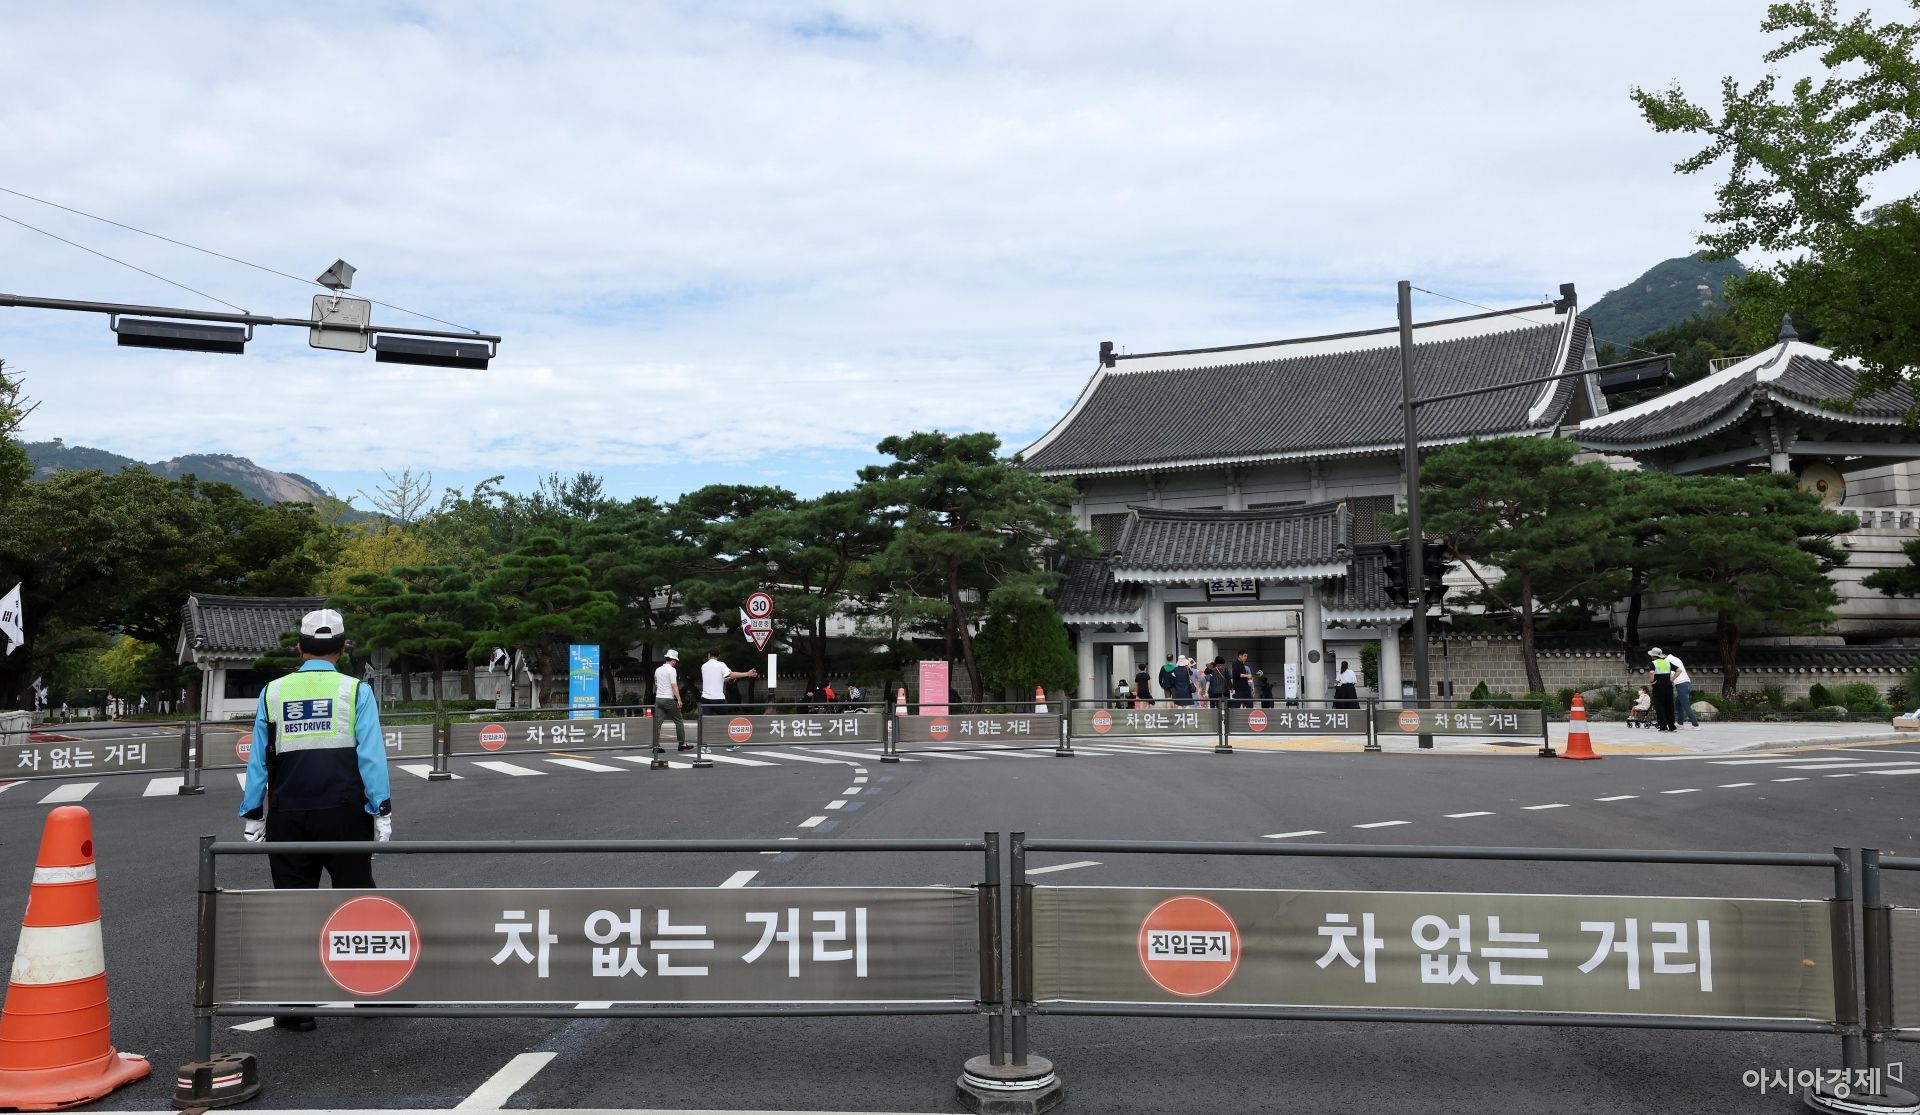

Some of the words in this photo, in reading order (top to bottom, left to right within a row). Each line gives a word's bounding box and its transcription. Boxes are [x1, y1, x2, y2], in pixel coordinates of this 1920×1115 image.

[752, 600, 766, 612] 30
[286, 700, 329, 720] 종로
[285, 722, 302, 733] BEST
[304, 721, 331, 732] DRIVER
[769, 720, 786, 738] 차
[791, 719, 823, 738] 없는
[828, 718, 859, 737] 거리
[960, 719, 973, 735] 차
[977, 719, 1002, 735] 없는
[1006, 719, 1031, 735] 거리
[1126, 713, 1140, 730] 차
[1144, 713, 1169, 729] 없는
[1175, 713, 1198, 729] 거리
[1280, 713, 1293, 729] 차
[1297, 713, 1321, 729] 없는
[1326, 713, 1349, 729] 거리
[1434, 713, 1449, 730] 차
[1454, 713, 1483, 729] 없는
[1489, 713, 1518, 730] 거리
[385, 731, 402, 751] 리
[526, 726, 544, 745] 차
[551, 724, 585, 744] 없는
[593, 722, 627, 742] 거리
[17, 749, 42, 771] 차
[49, 747, 95, 770] 없는
[103, 743, 147, 766] 거리
[333, 935, 407, 955] 진입금지
[491, 909, 558, 979] 차
[583, 908, 715, 979] 없는
[741, 907, 868, 979] 거리
[1150, 932, 1232, 956] 진입금지
[1315, 912, 1385, 984] 차
[1411, 914, 1549, 987] 없는
[1578, 918, 1714, 993] 거리
